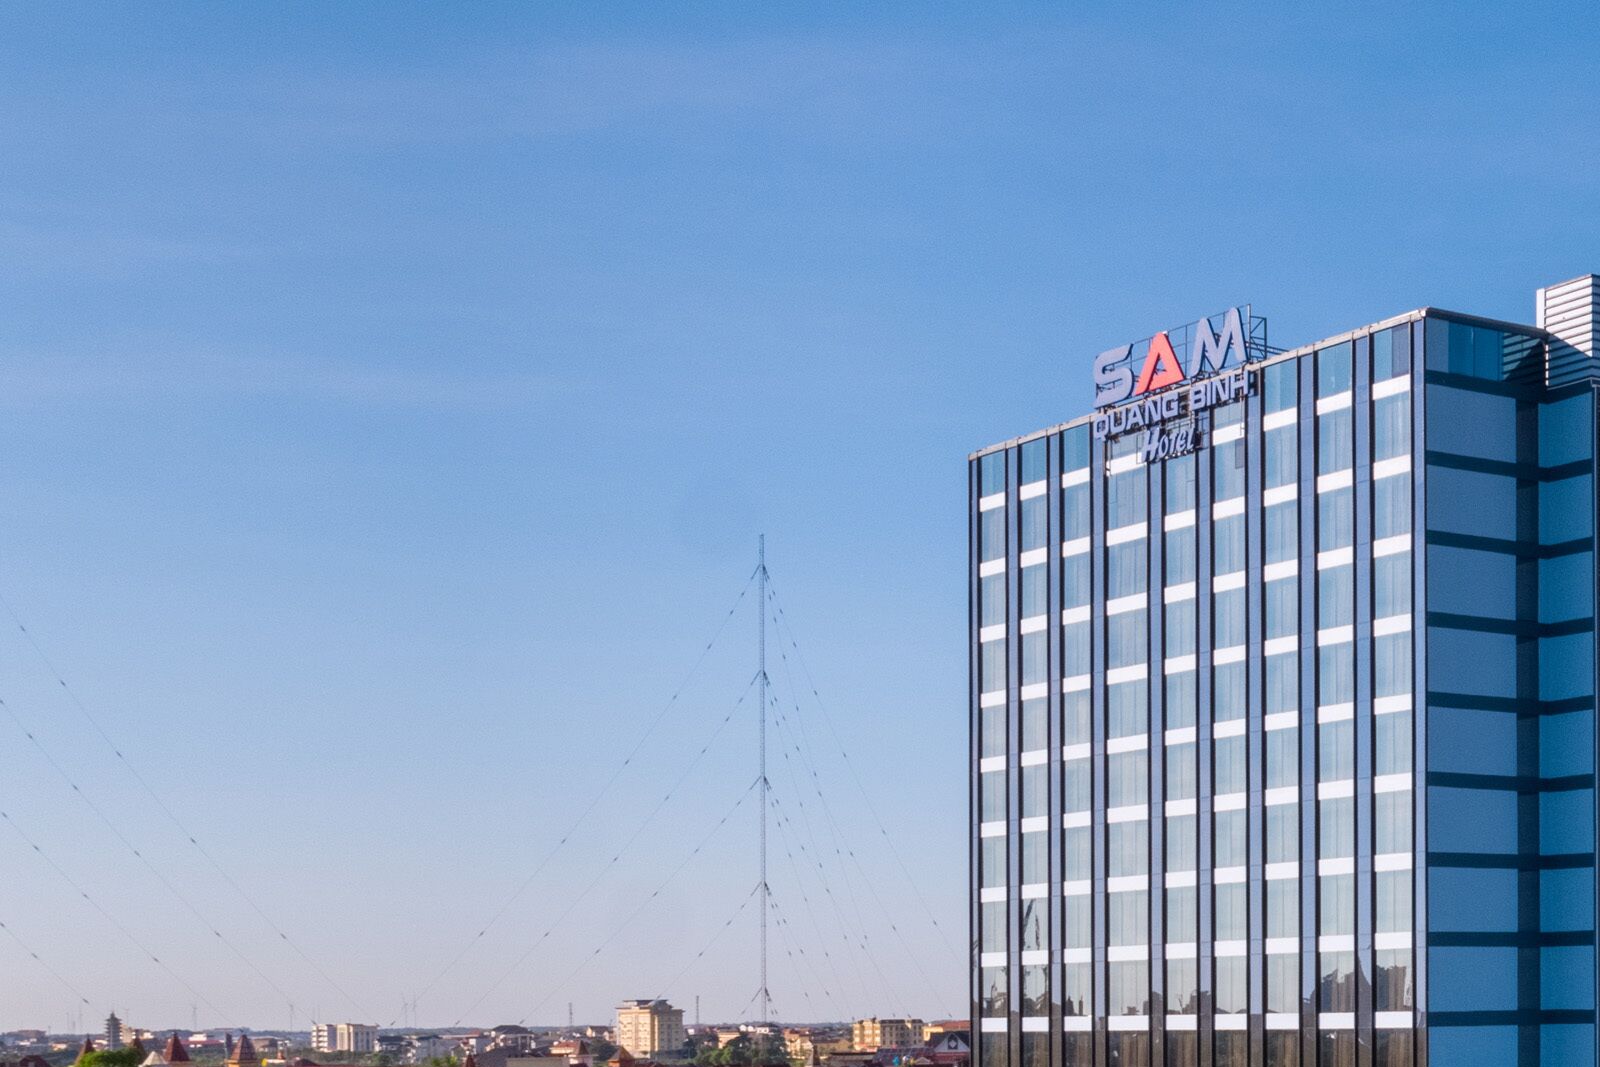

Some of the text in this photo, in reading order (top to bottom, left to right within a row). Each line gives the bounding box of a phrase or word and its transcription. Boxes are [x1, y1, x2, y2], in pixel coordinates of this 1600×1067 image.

[1093, 307, 1248, 409] SAM
[1094, 369, 1249, 440] QUANG BINH
